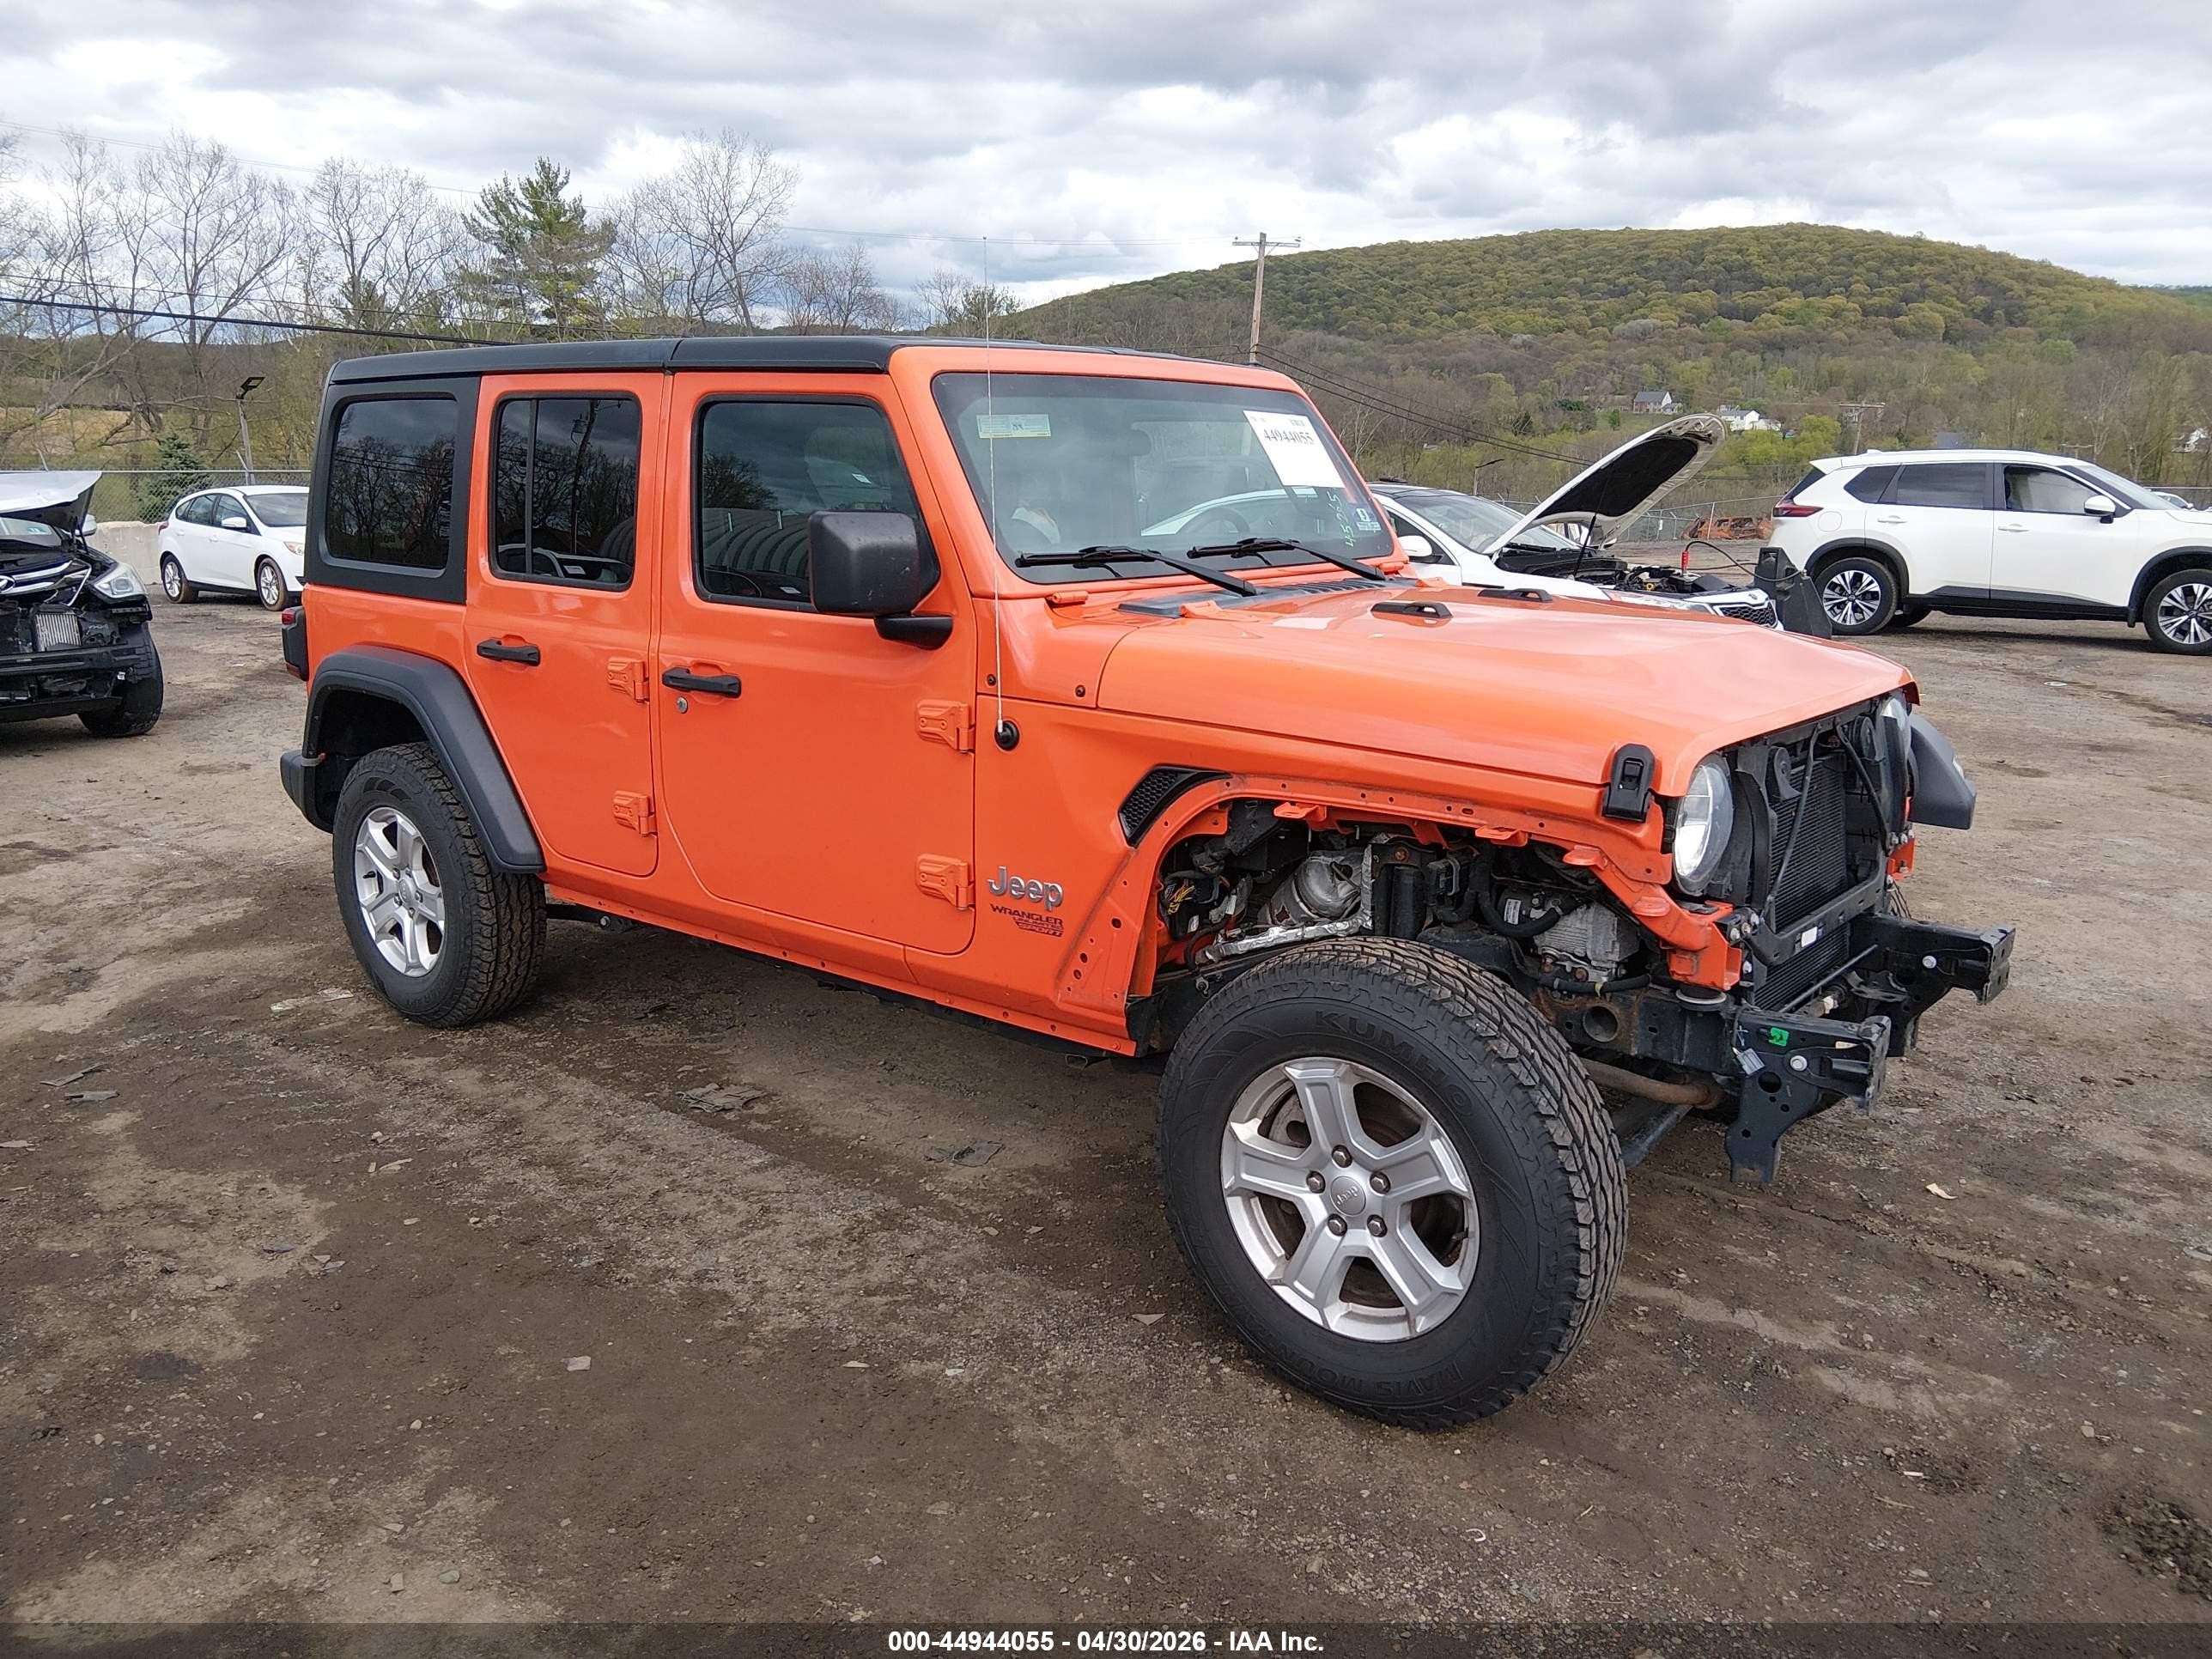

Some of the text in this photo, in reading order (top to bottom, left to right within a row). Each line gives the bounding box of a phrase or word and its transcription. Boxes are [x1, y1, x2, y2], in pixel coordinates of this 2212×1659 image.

[1263, 428, 1315, 445] 44944055
[987, 866, 1064, 913] Jeep
[989, 902, 1064, 927] WRANGLER
[1019, 923, 1063, 937] SPORT
[1314, 1009, 1474, 1118] KUMHO
[1336, 1185, 1358, 1206] Jeep
